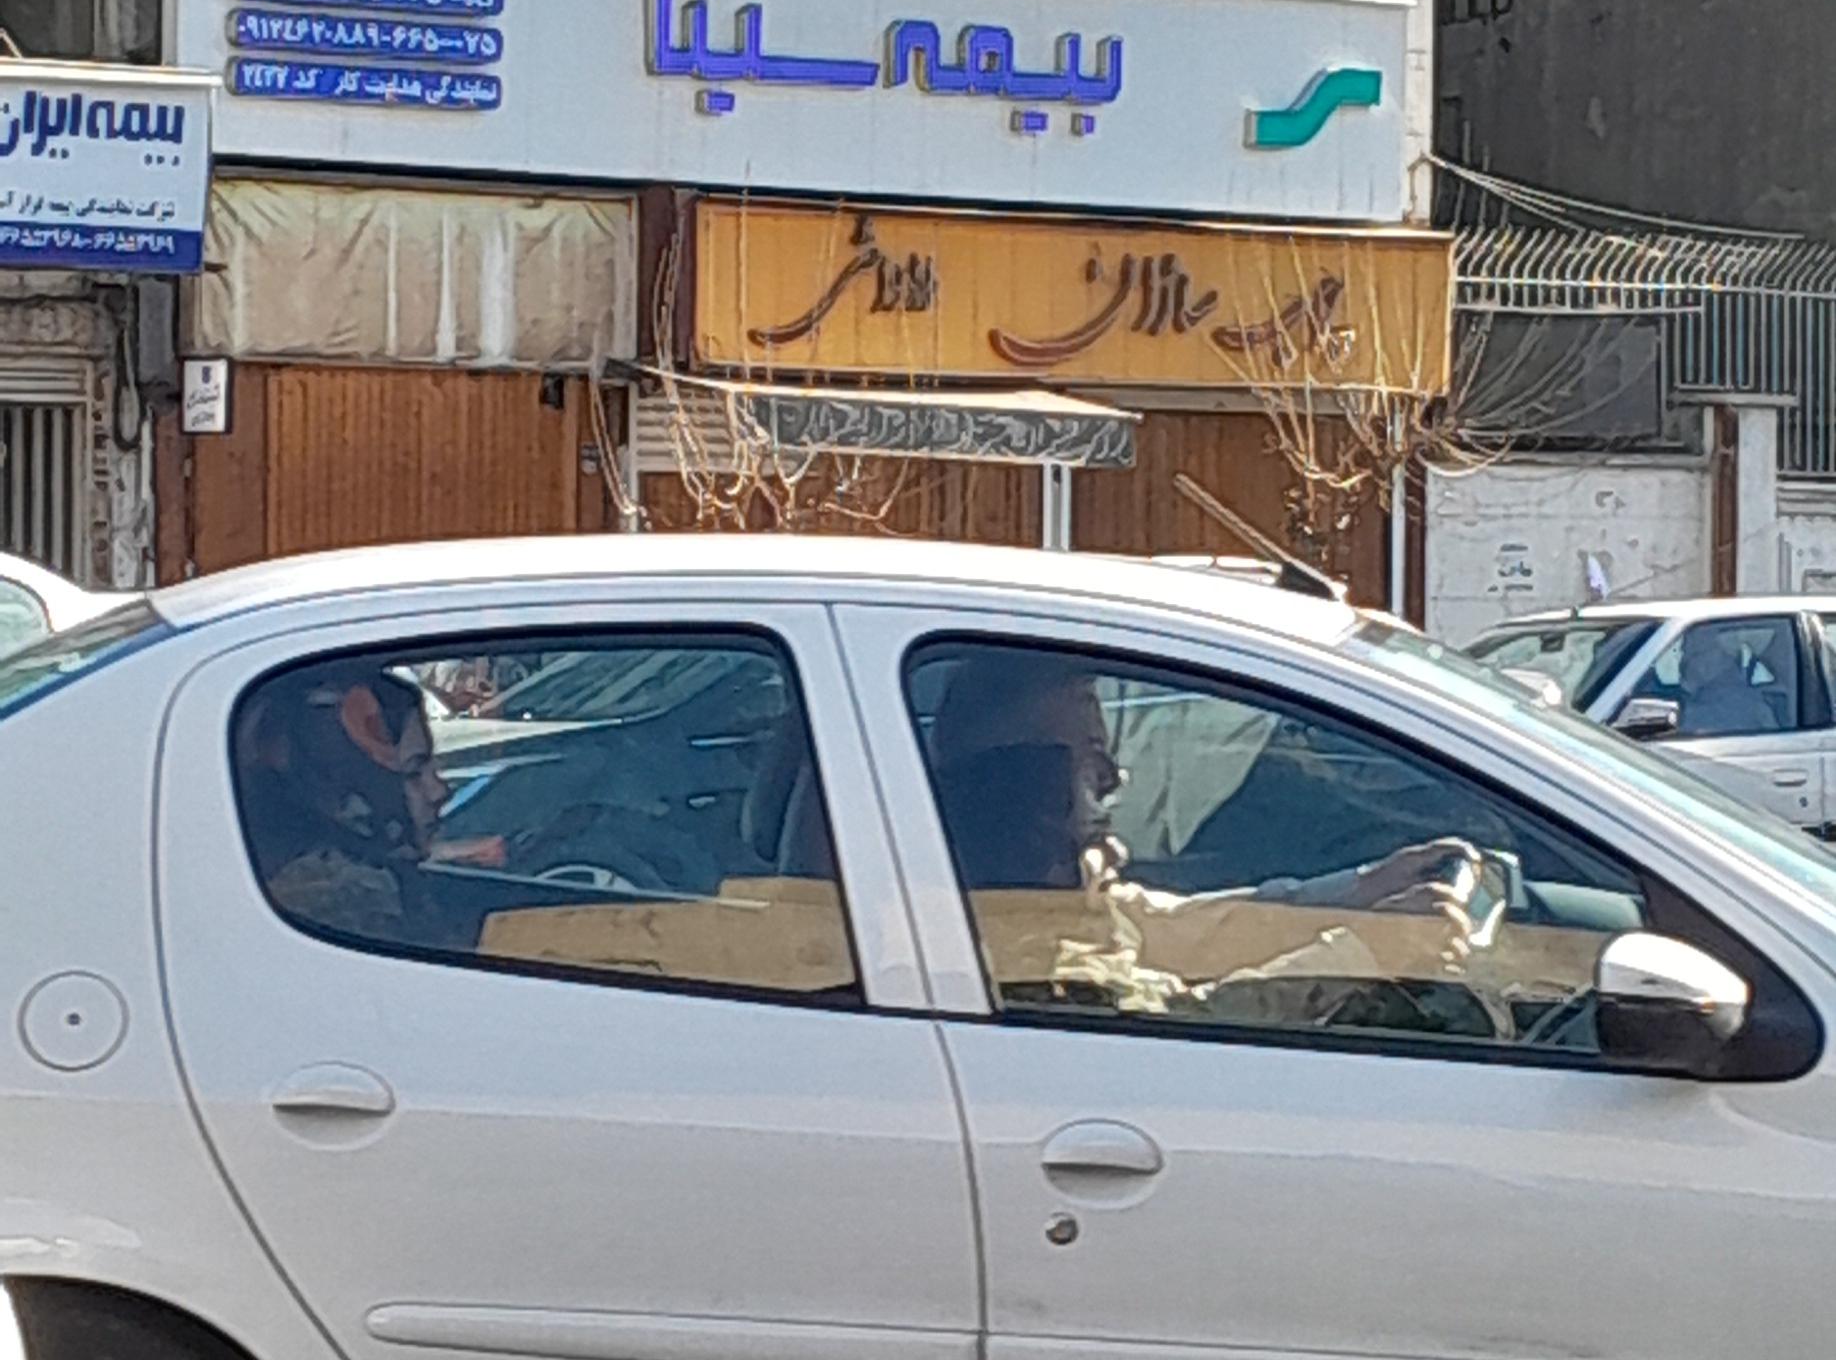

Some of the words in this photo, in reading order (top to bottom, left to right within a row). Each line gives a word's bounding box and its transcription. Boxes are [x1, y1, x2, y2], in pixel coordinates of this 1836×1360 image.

[86, 99, 185, 166] بیمه
[882, 18, 1124, 137] بیمه
[987, 248, 1218, 366] سازان
